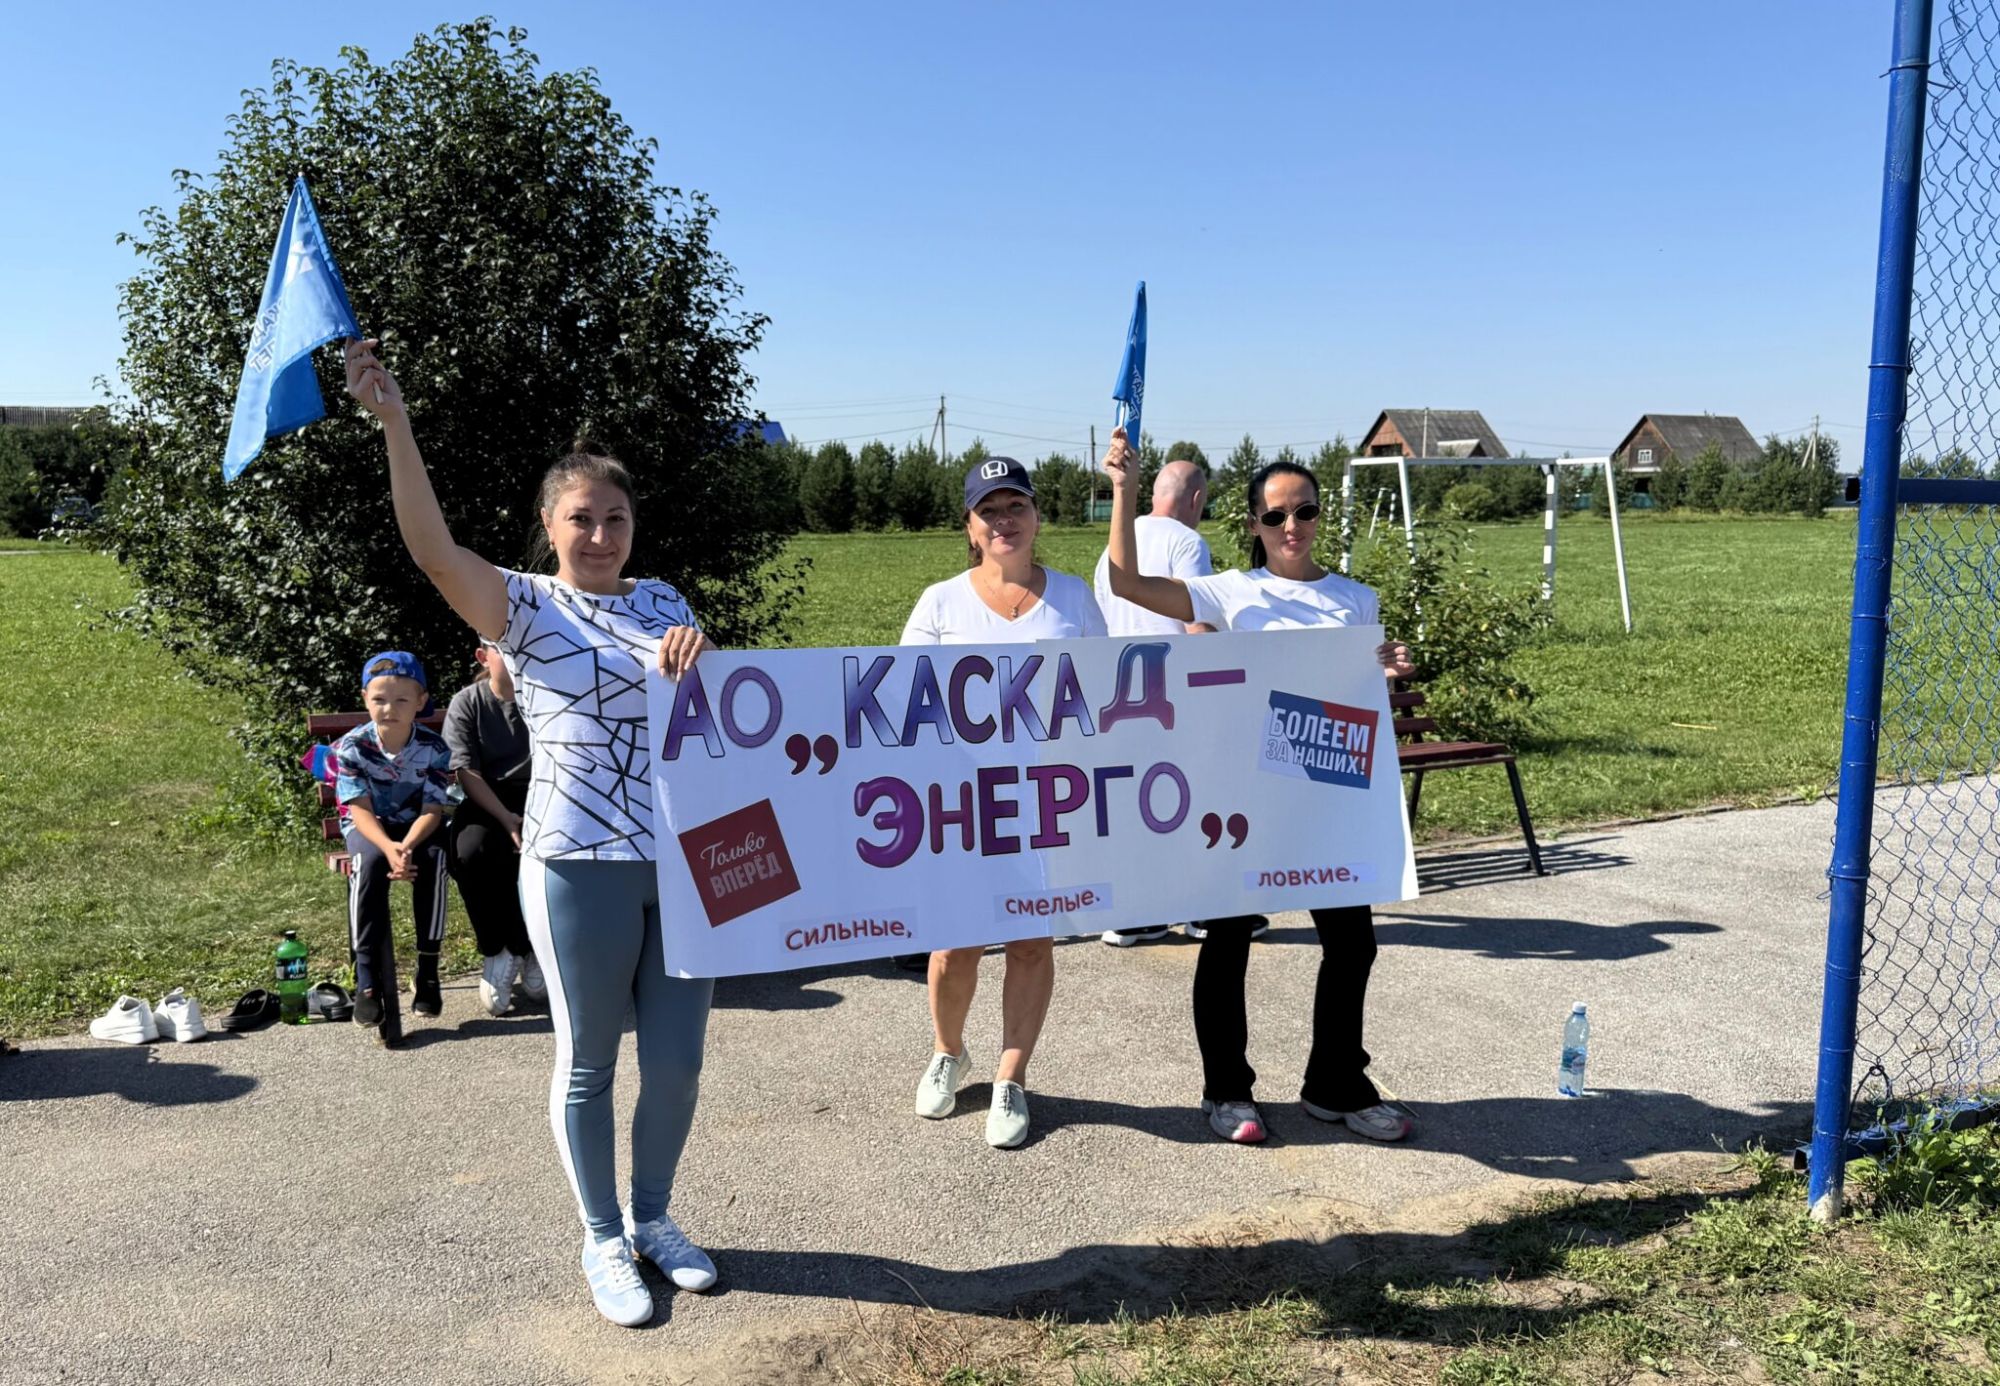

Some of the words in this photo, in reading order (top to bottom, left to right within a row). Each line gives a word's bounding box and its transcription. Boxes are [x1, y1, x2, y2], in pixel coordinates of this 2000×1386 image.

[662, 665, 783, 760] АО
[1270, 707, 1370, 753] БОЛЕЕМ
[1266, 739, 1289, 763] ЗА
[1293, 744, 1367, 776] НАШИХ!
[700, 831, 767, 870] Только
[709, 851, 783, 899] ВПЕРЁД
[1258, 866, 1359, 887] ловкие,
